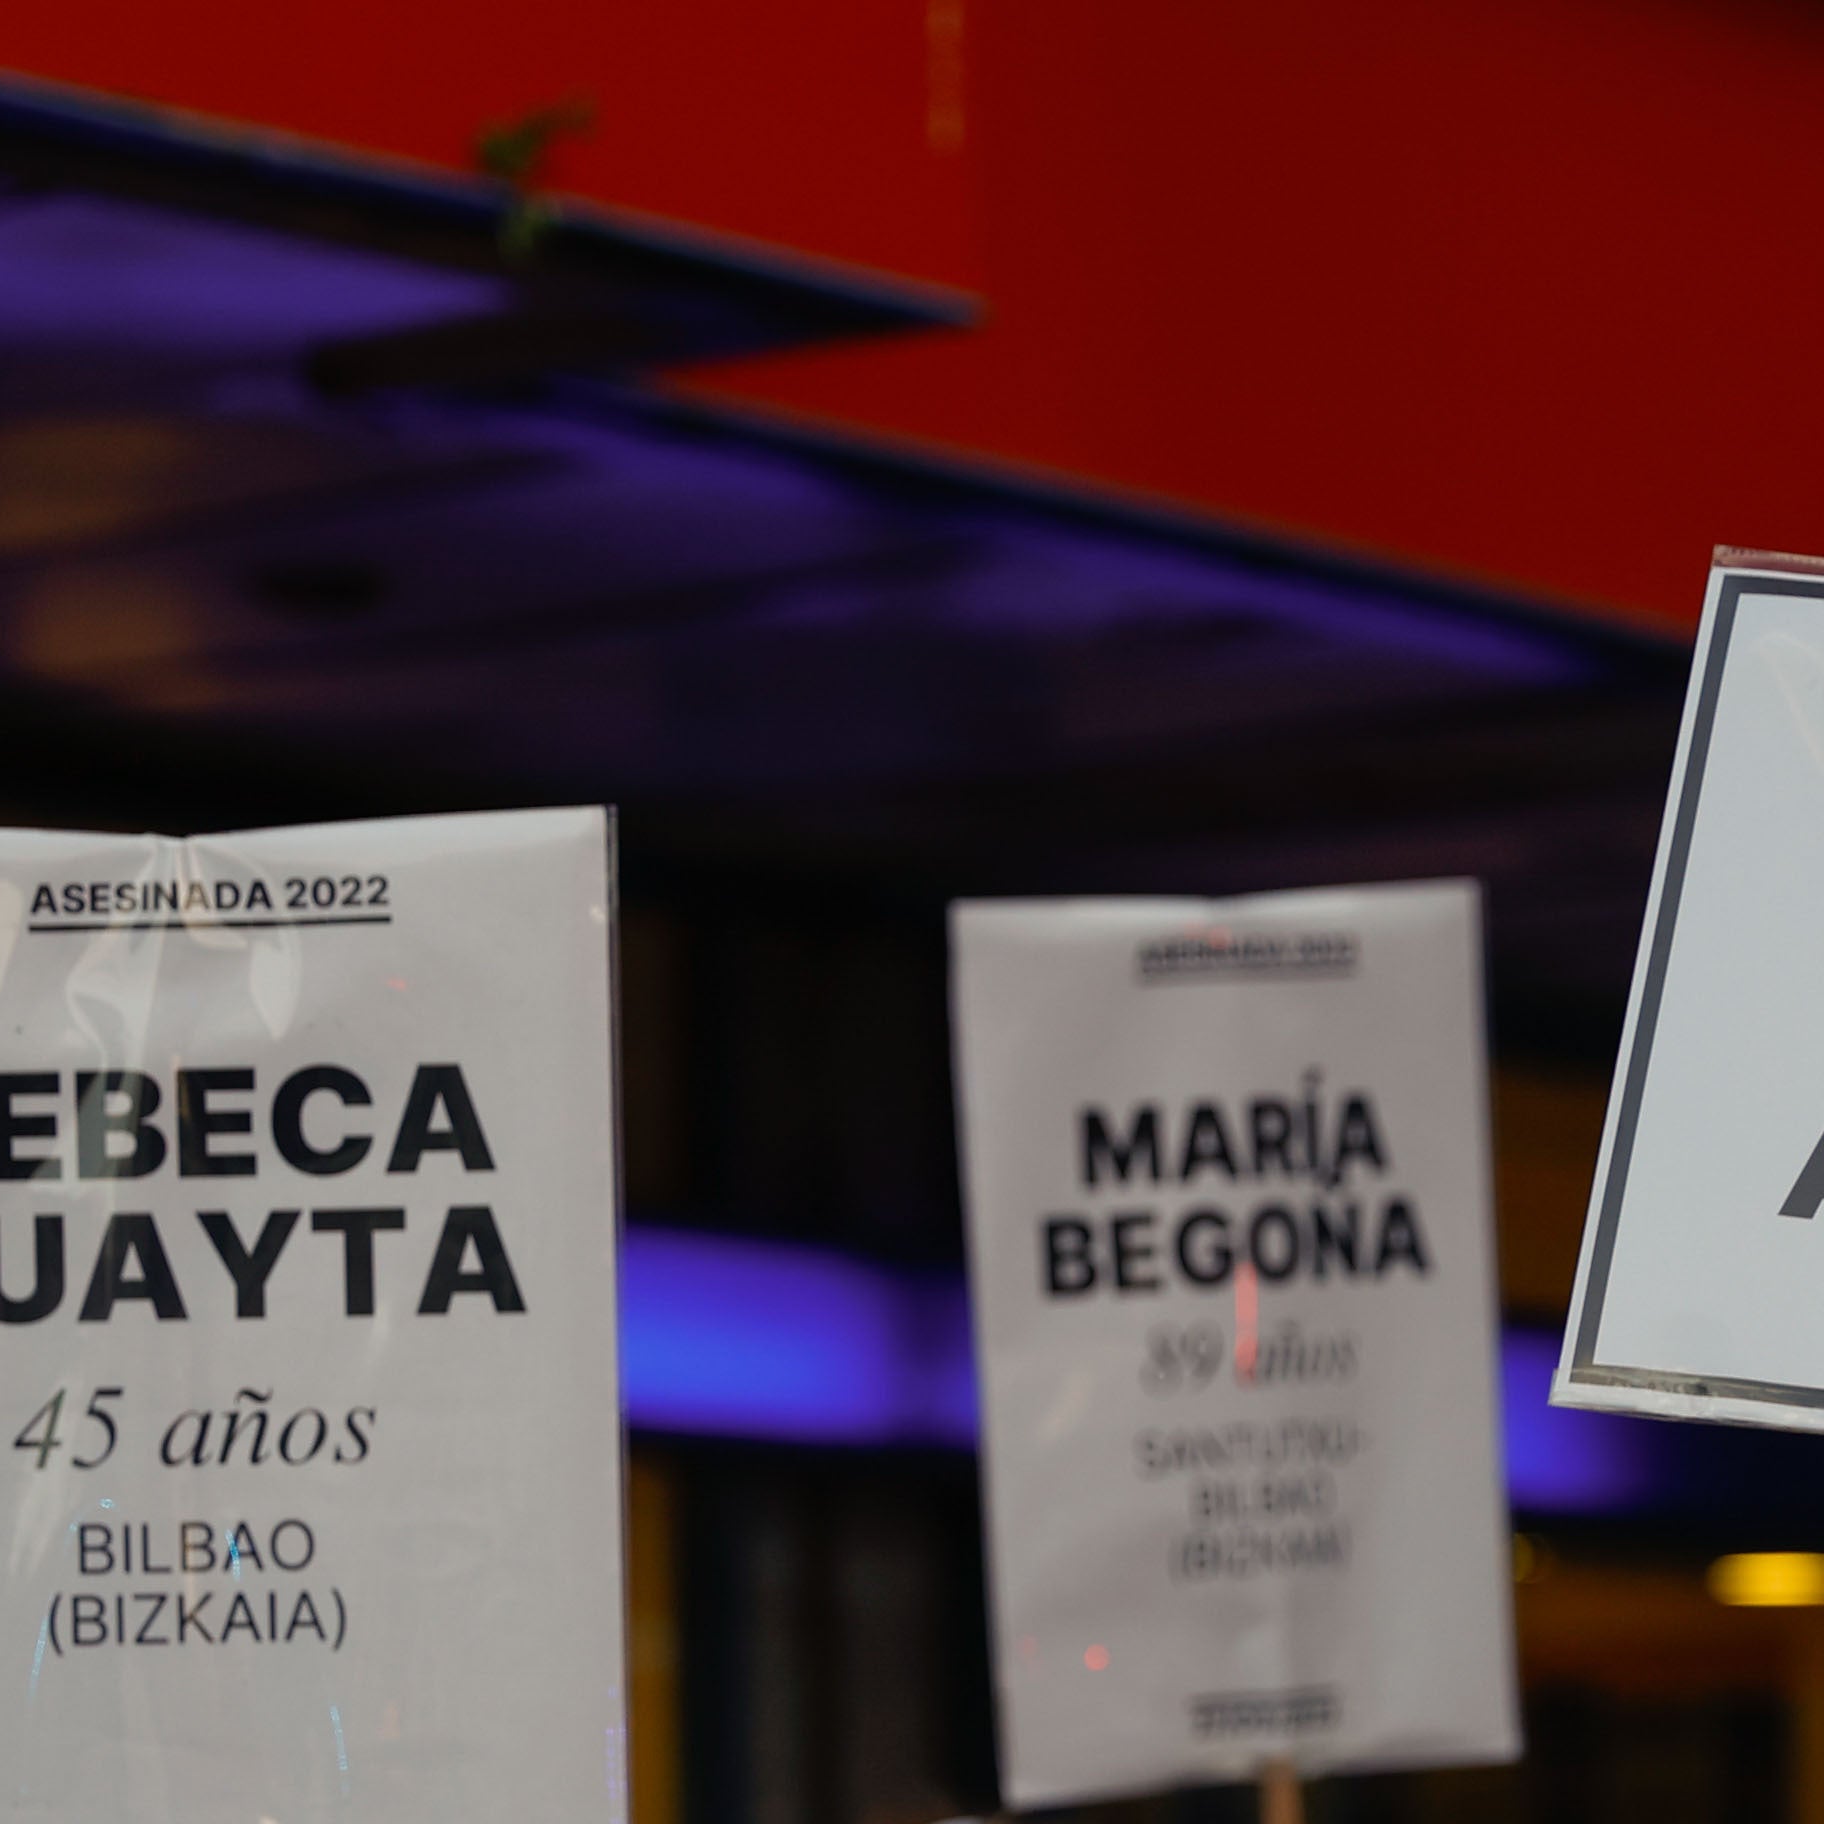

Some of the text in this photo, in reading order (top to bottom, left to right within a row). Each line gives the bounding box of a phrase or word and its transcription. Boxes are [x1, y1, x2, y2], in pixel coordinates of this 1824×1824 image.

[30, 874, 390, 915] ASESINADA 2022
[1079, 1066, 1390, 1192] MARÍA
[1042, 1180, 1435, 1299] BEGOÑA
[13, 1388, 376, 1470] 45 años
[76, 1520, 315, 1576] BILBAO
[48, 1588, 348, 1653] (BIZKAIA)
